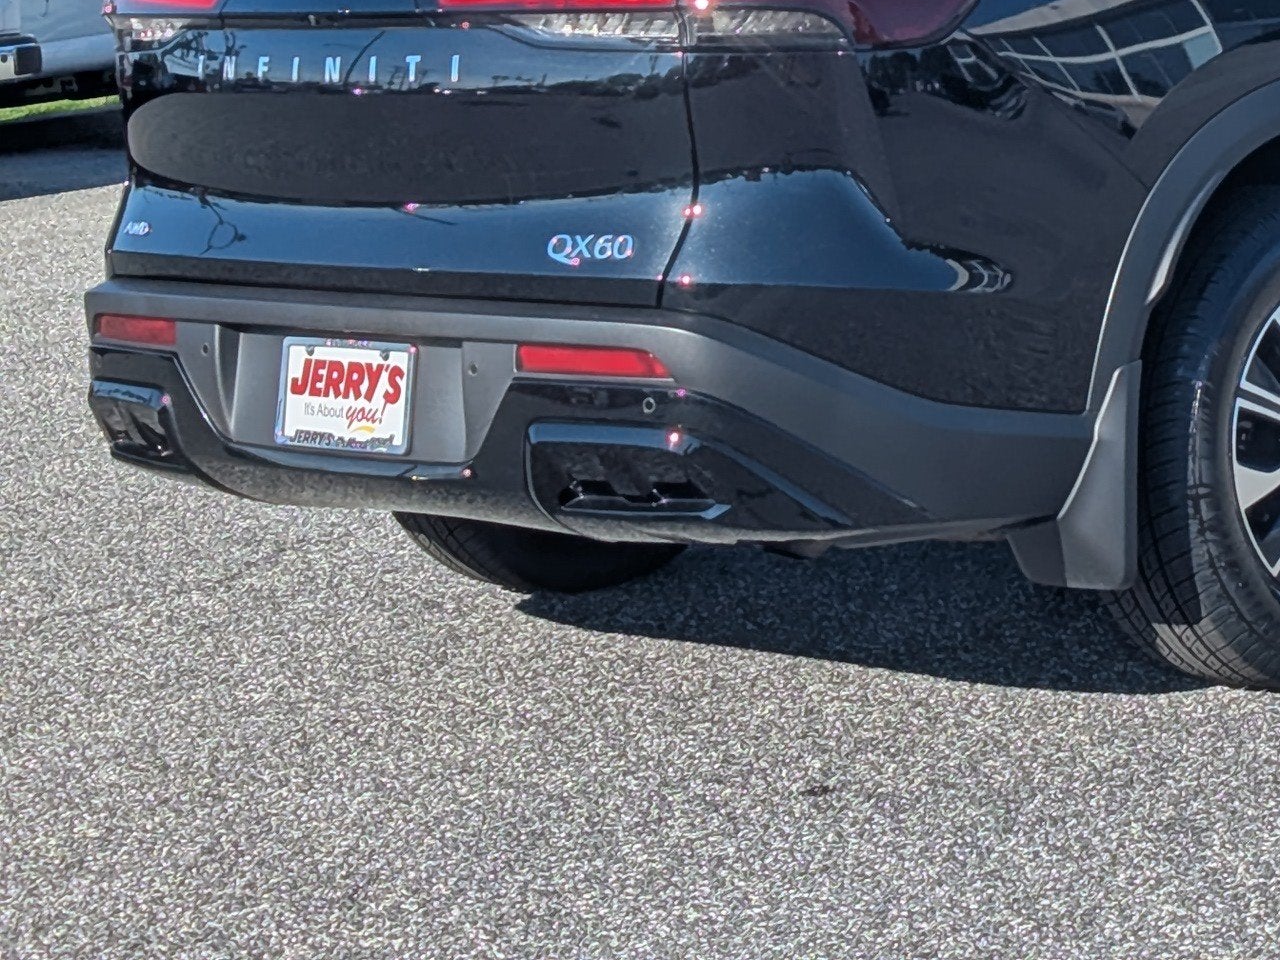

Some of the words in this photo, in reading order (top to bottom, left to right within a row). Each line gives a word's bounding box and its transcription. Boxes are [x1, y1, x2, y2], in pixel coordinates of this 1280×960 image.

[198, 54, 461, 83] INFINITI
[547, 234, 634, 266] QX60
[290, 358, 405, 405] JERRY'S
[303, 401, 316, 416] It's
[317, 403, 344, 419] About
[346, 401, 386, 429] you!
